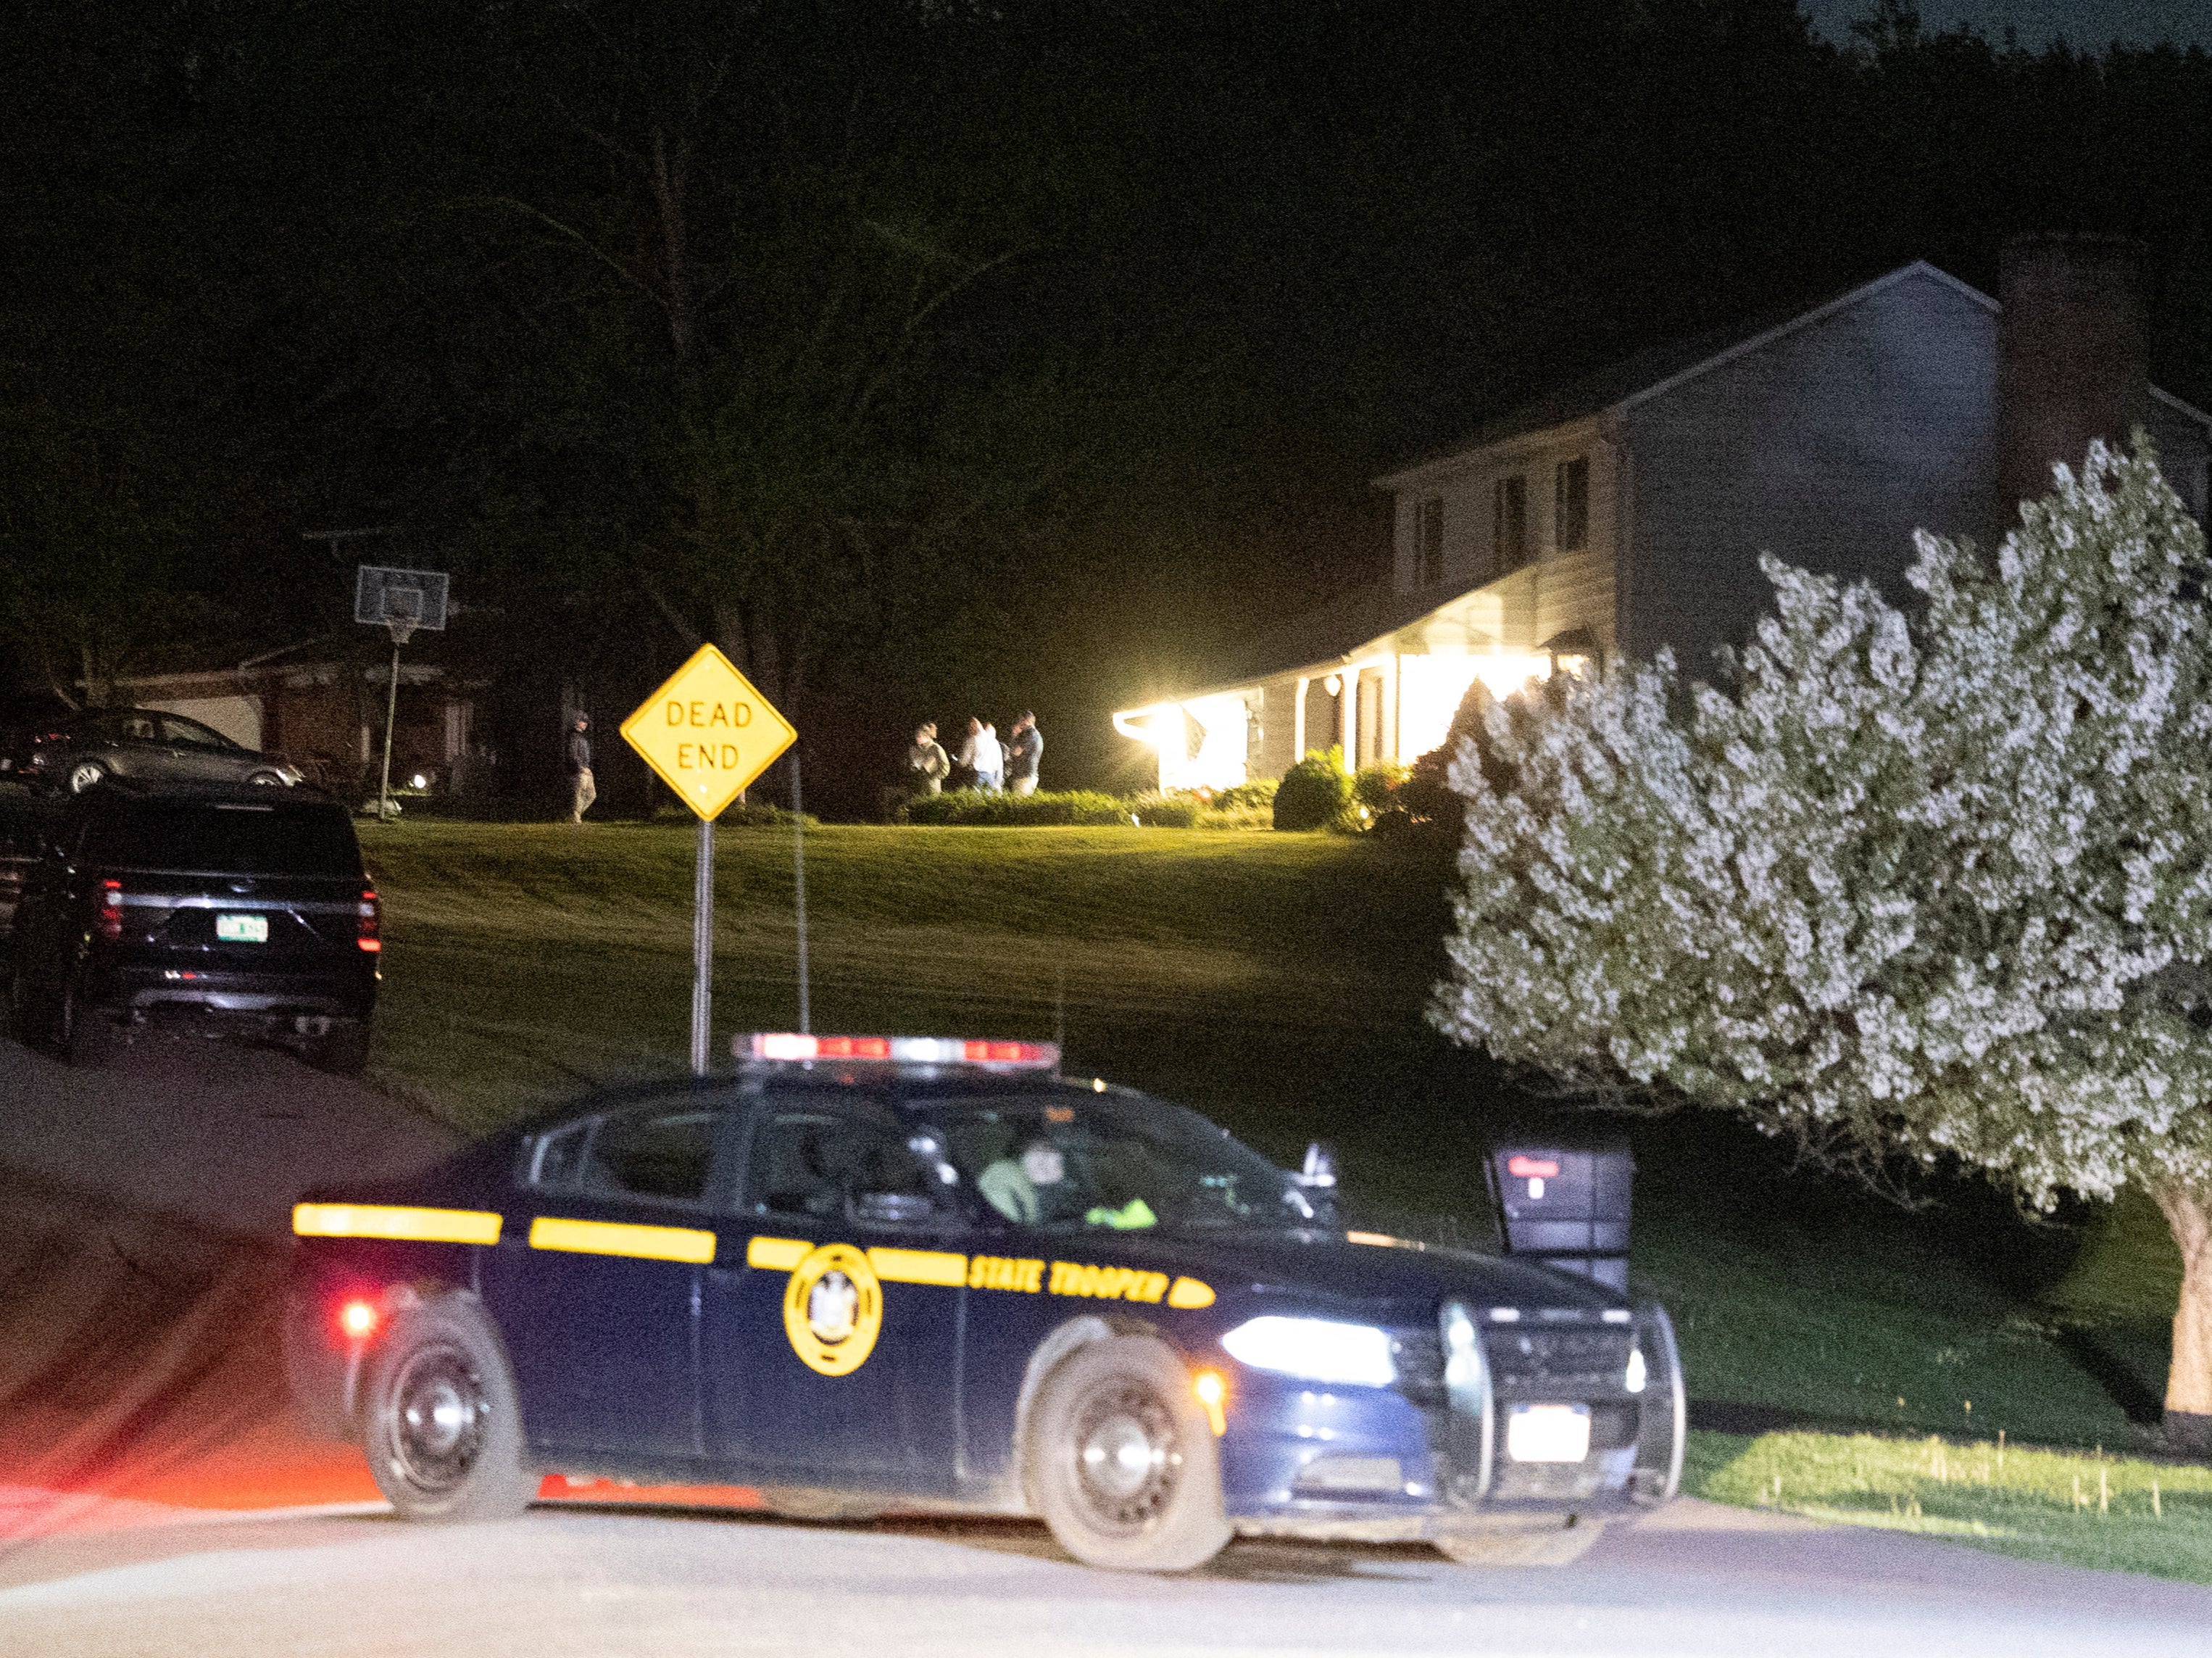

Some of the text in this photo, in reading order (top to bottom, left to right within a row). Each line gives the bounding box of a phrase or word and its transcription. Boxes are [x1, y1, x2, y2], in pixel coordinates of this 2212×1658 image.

[666, 701, 752, 728] DEAD
[678, 744, 739, 771] END
[968, 1254, 1169, 1304] STATE TROOPER
